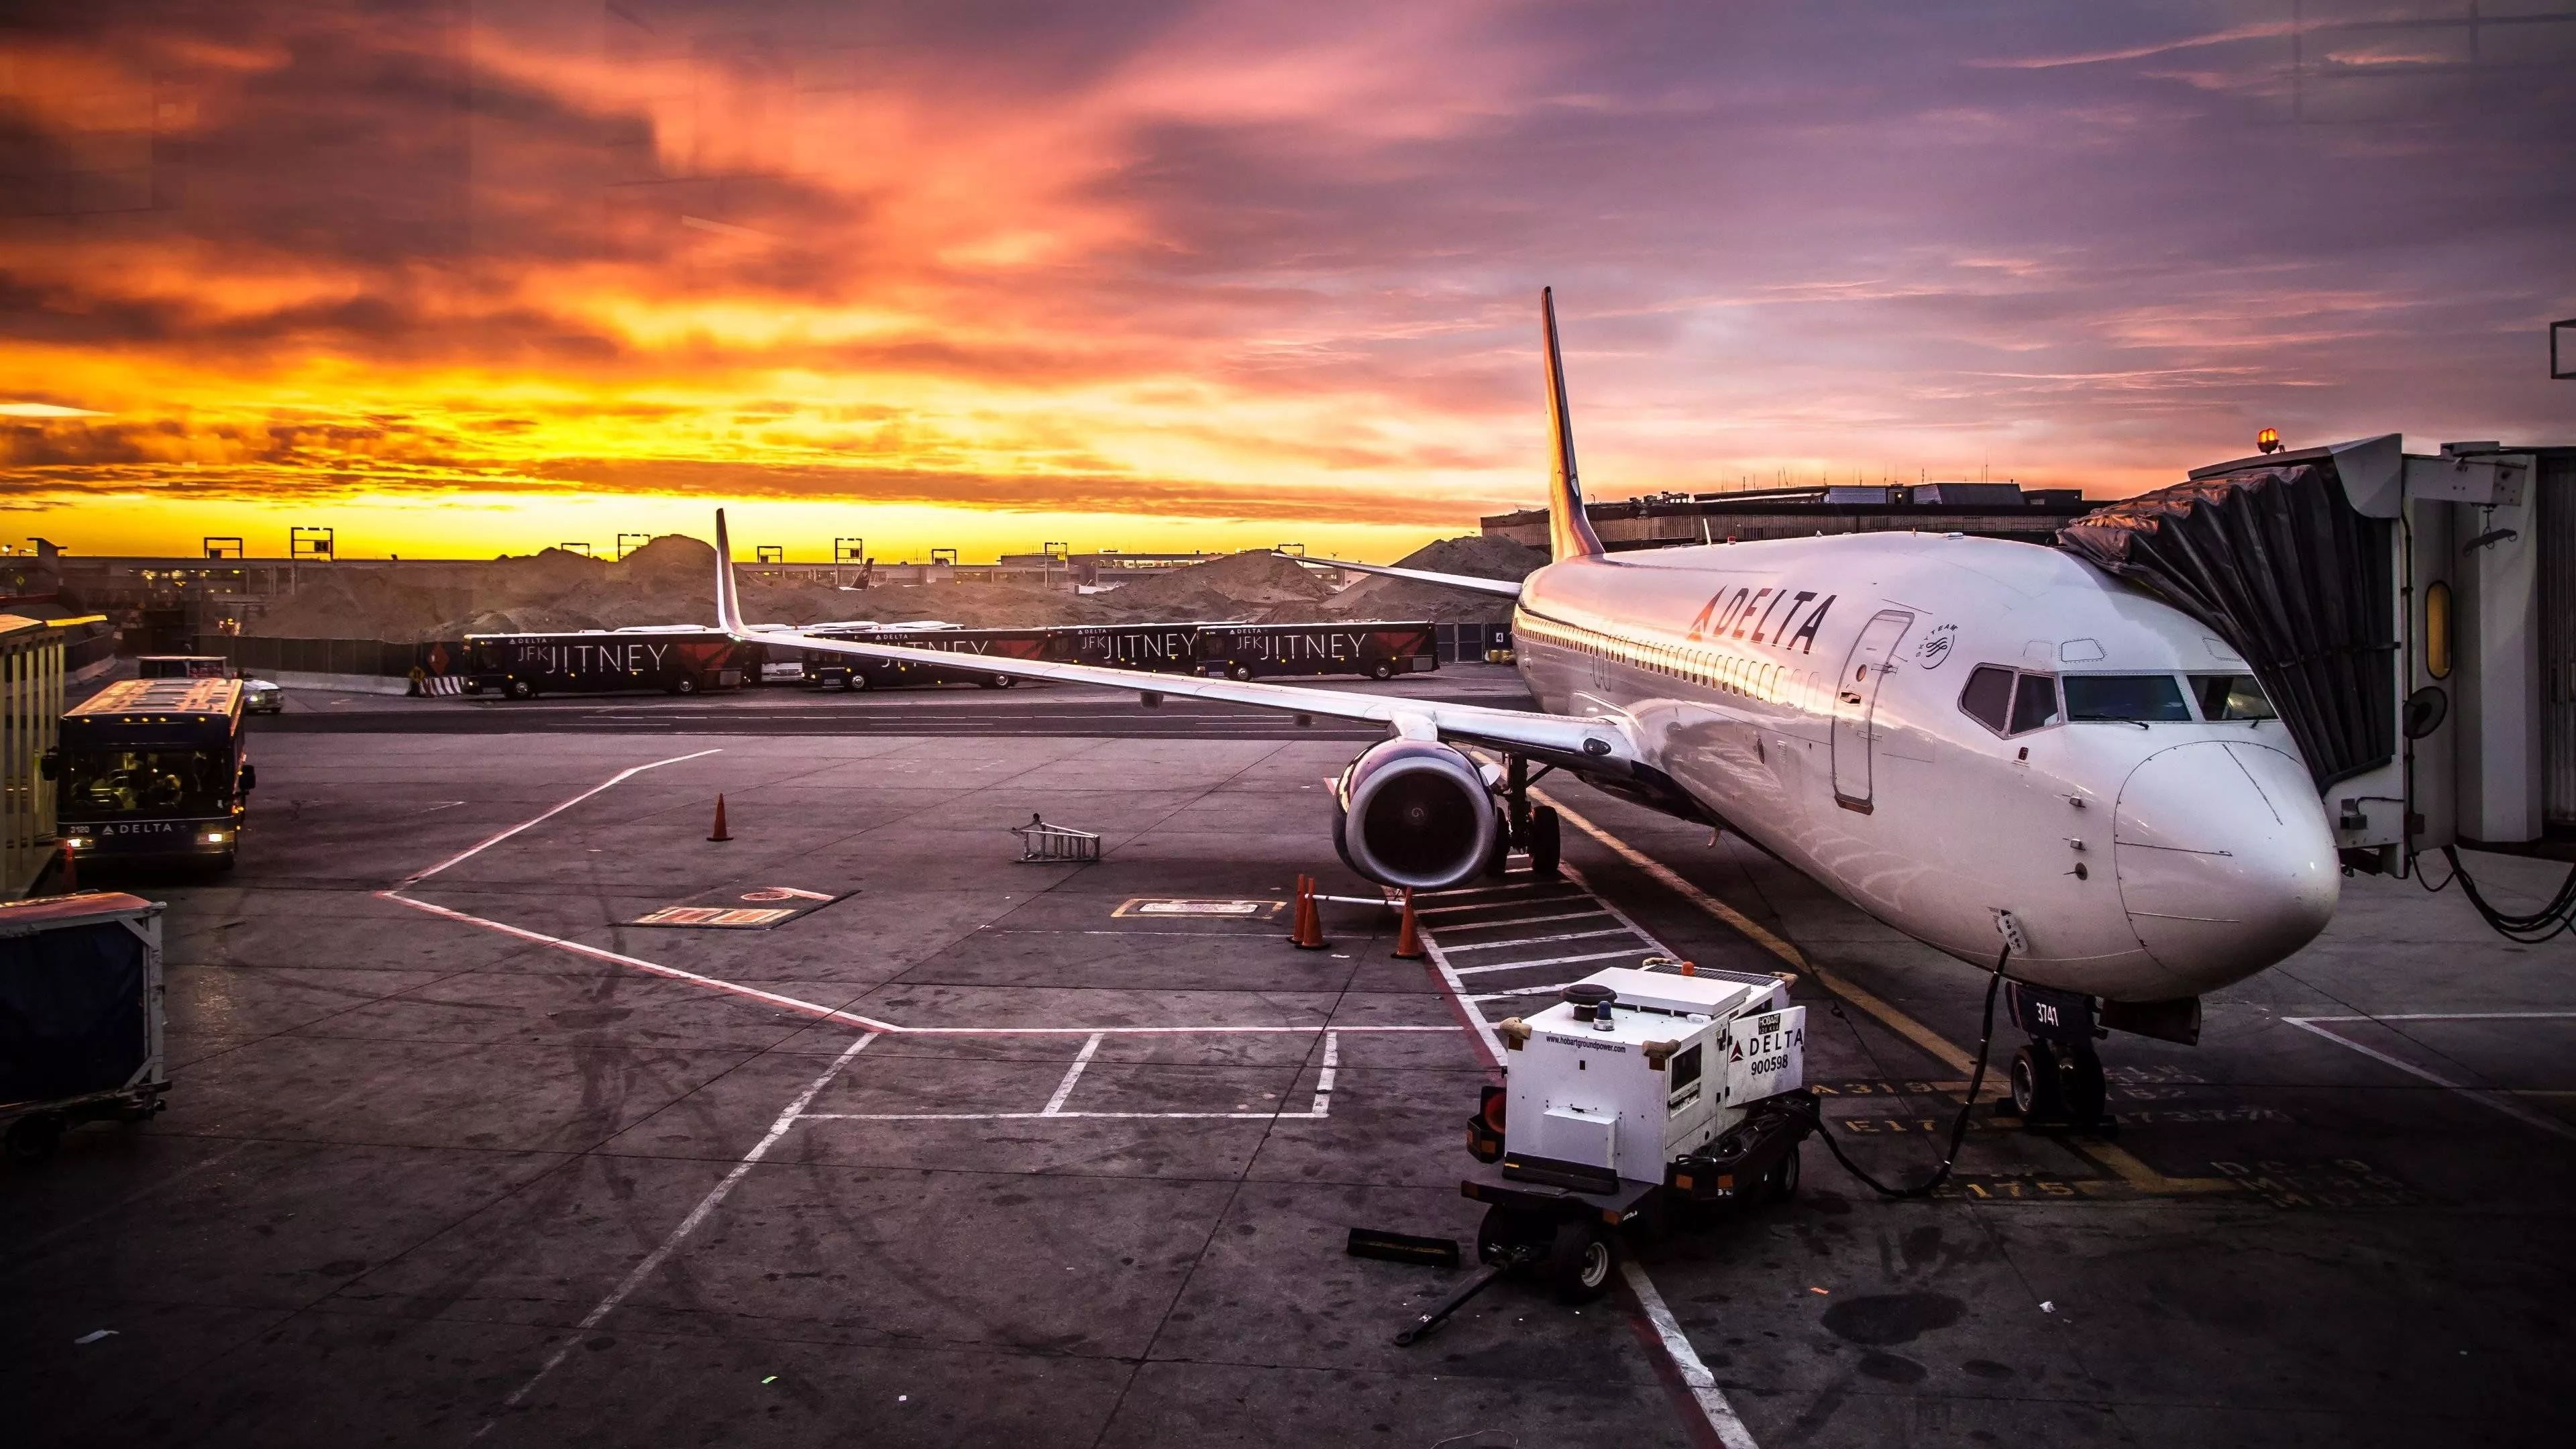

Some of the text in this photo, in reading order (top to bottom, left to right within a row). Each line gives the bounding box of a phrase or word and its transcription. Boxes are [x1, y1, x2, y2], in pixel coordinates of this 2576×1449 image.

[1712, 588, 1837, 655] DELTA
[518, 644, 668, 674] JFK JITNEY
[1082, 633, 1196, 659] JFK JITNEY
[1237, 633, 1366, 660] JFK JITNEY
[119, 823, 172, 834] DELTA
[2036, 1002, 2059, 1027] 3741
[1546, 1034, 1627, 1054] www.hobartgroundpower.com
[1750, 1028, 1804, 1057] DELTA
[1752, 1054, 1789, 1076] 900598
